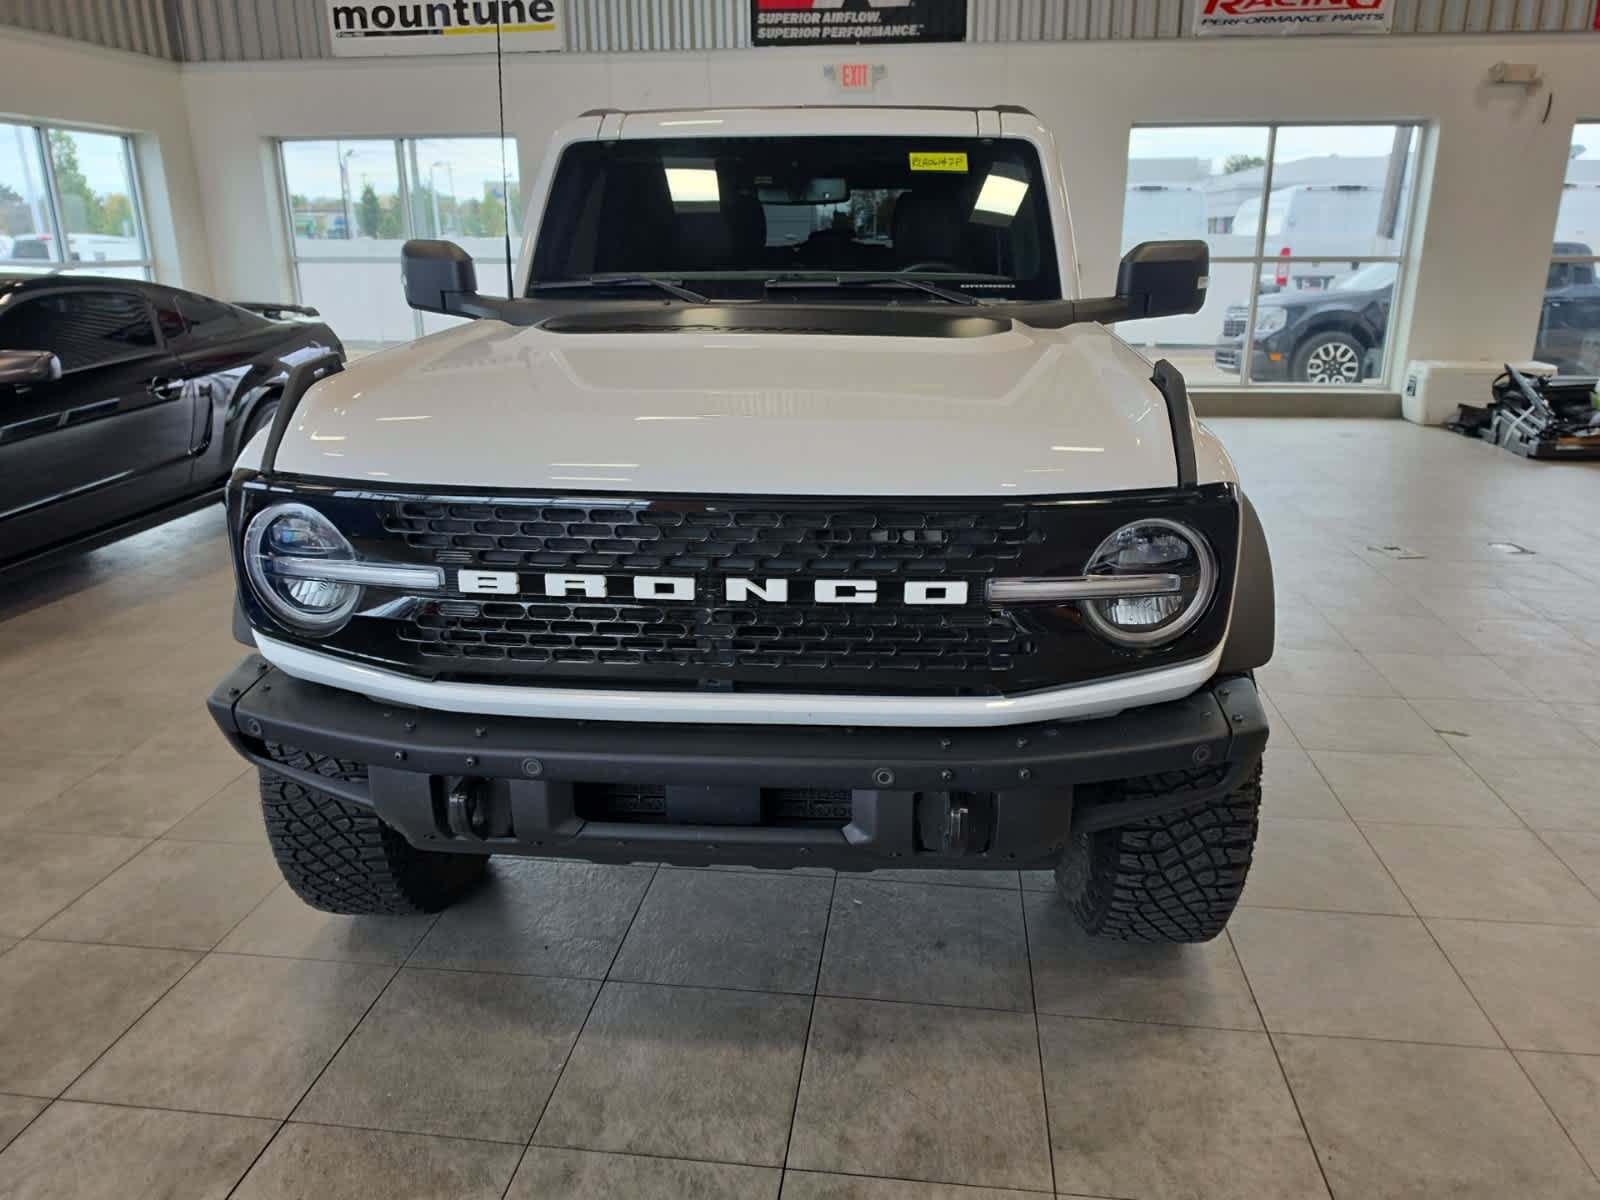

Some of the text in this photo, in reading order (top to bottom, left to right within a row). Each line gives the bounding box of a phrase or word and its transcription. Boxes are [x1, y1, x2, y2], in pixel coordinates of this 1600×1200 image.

[332, 0, 555, 30] mountune
[757, 11, 881, 25] SUPERIOR AIRFLOW.
[1201, 13, 1384, 26] PERFORMANCE PARTS
[757, 27, 820, 39] SUPERIOR
[841, 64, 868, 88] EXIT
[458, 569, 968, 605] BRONCO
